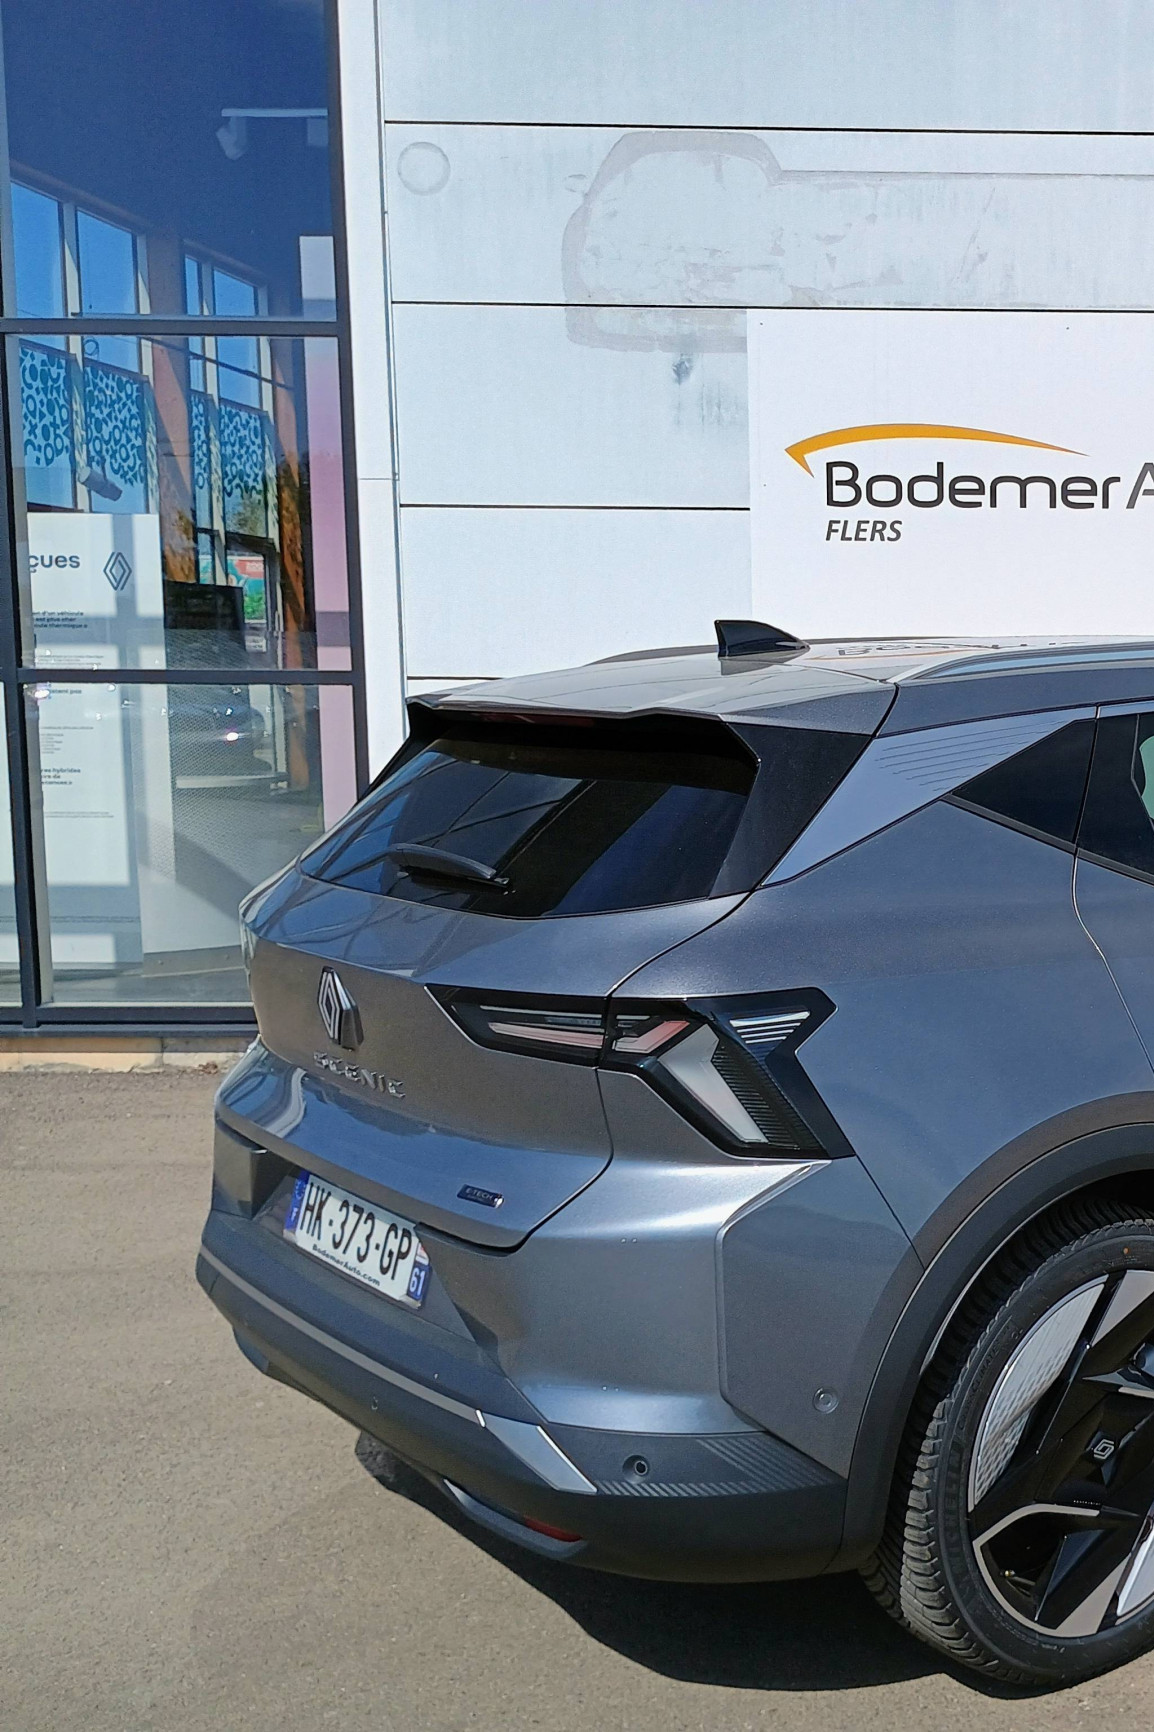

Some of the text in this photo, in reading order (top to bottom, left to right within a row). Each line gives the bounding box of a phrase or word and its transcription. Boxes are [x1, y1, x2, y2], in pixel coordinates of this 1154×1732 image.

[825, 519, 902, 542] FLERS
[313, 1051, 406, 1098] SCENIC
[299, 1181, 413, 1281] HK-373-GP
[408, 1267, 427, 1297] 61
